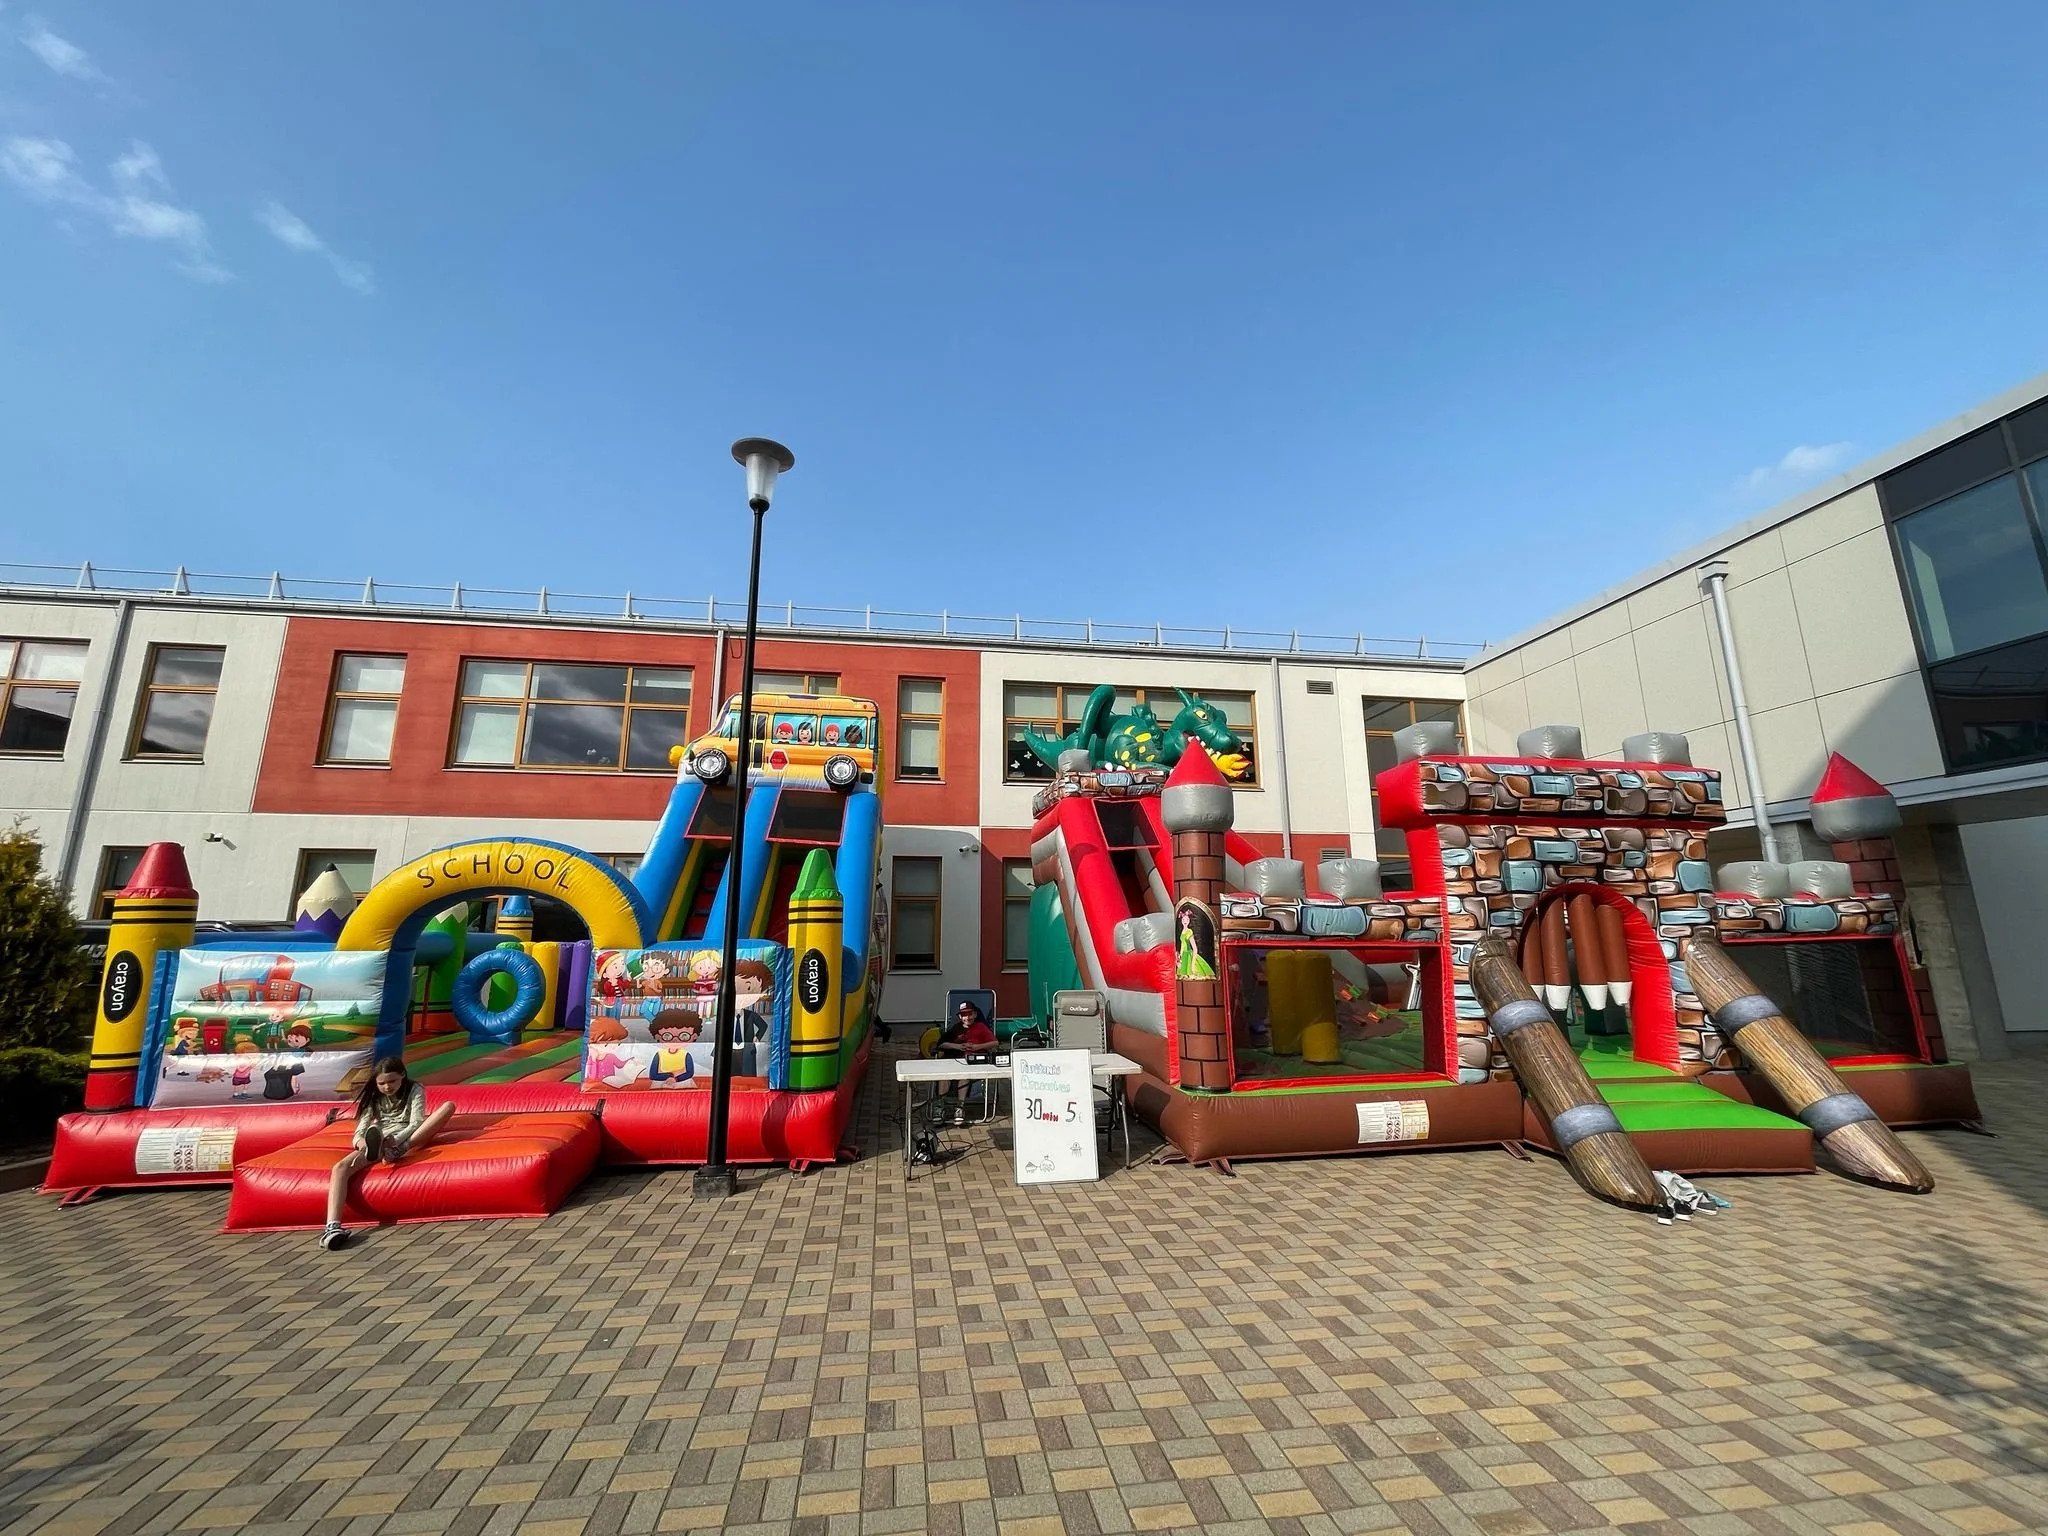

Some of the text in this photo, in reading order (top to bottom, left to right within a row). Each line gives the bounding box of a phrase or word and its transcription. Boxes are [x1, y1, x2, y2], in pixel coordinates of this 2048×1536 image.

[417, 854, 573, 889] SCHOOL
[111, 962, 129, 1011] crayon
[806, 959, 819, 1003] crayon
